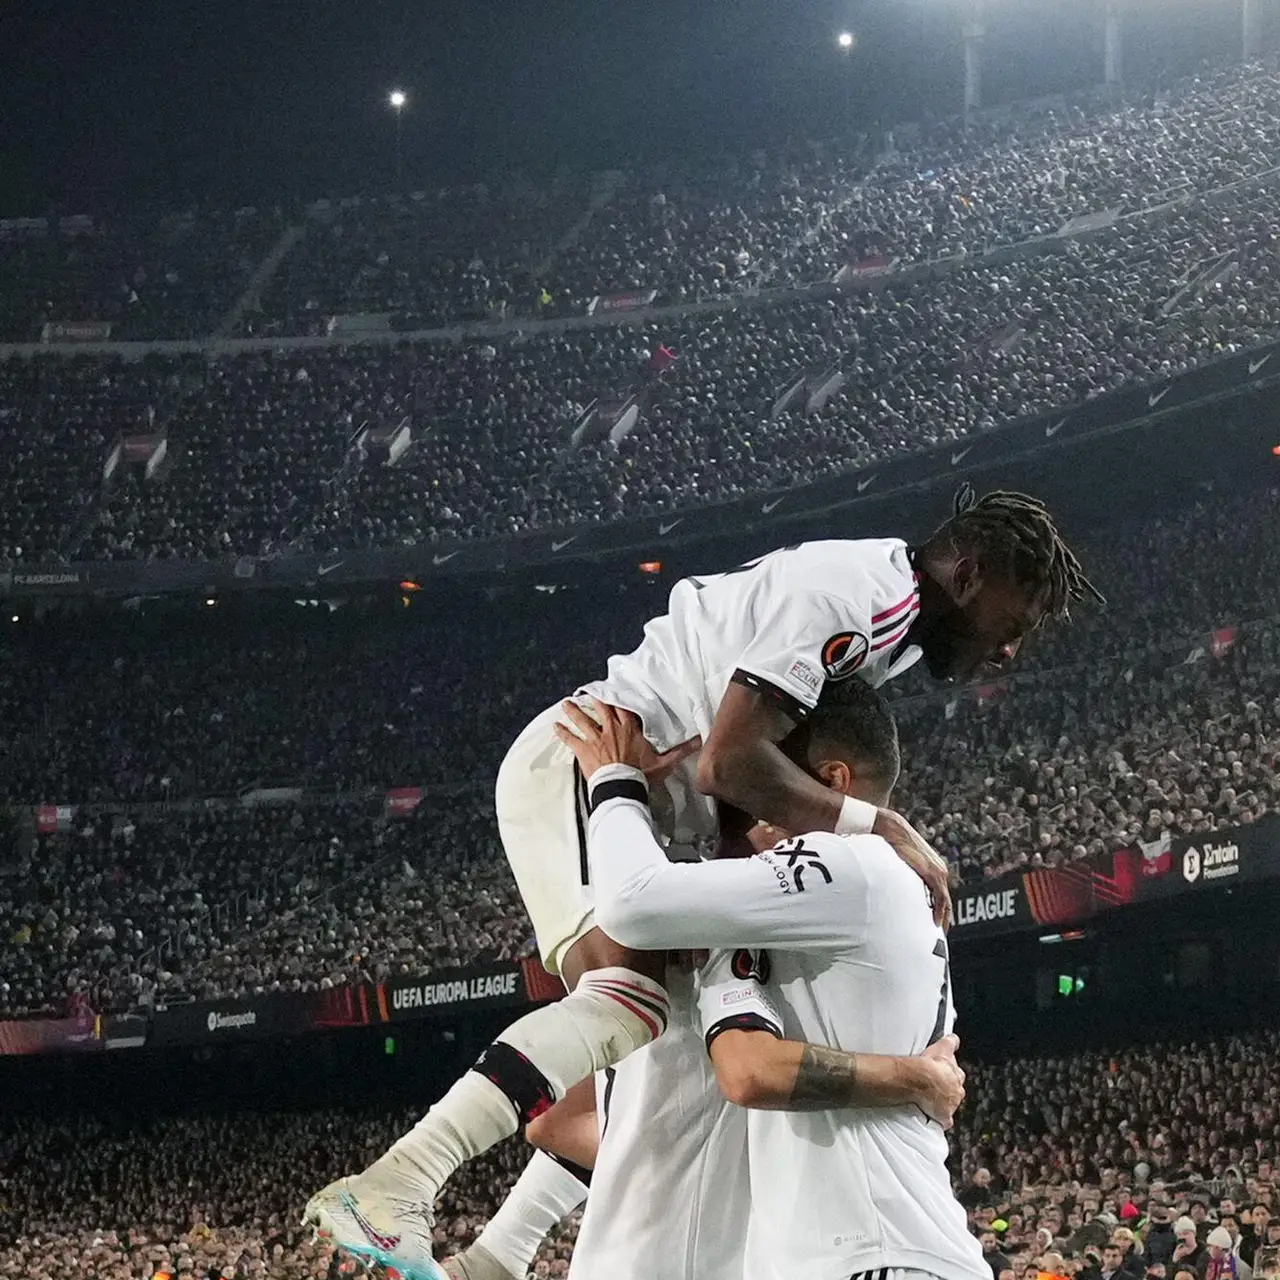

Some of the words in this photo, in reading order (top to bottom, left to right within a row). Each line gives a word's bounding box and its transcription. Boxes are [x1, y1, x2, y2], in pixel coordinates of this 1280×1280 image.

[957, 889, 1017, 926] LEAGUE
[393, 985, 423, 1010] UEFA
[424, 978, 469, 1006] EUROPA
[470, 972, 518, 999] LEAGUE
